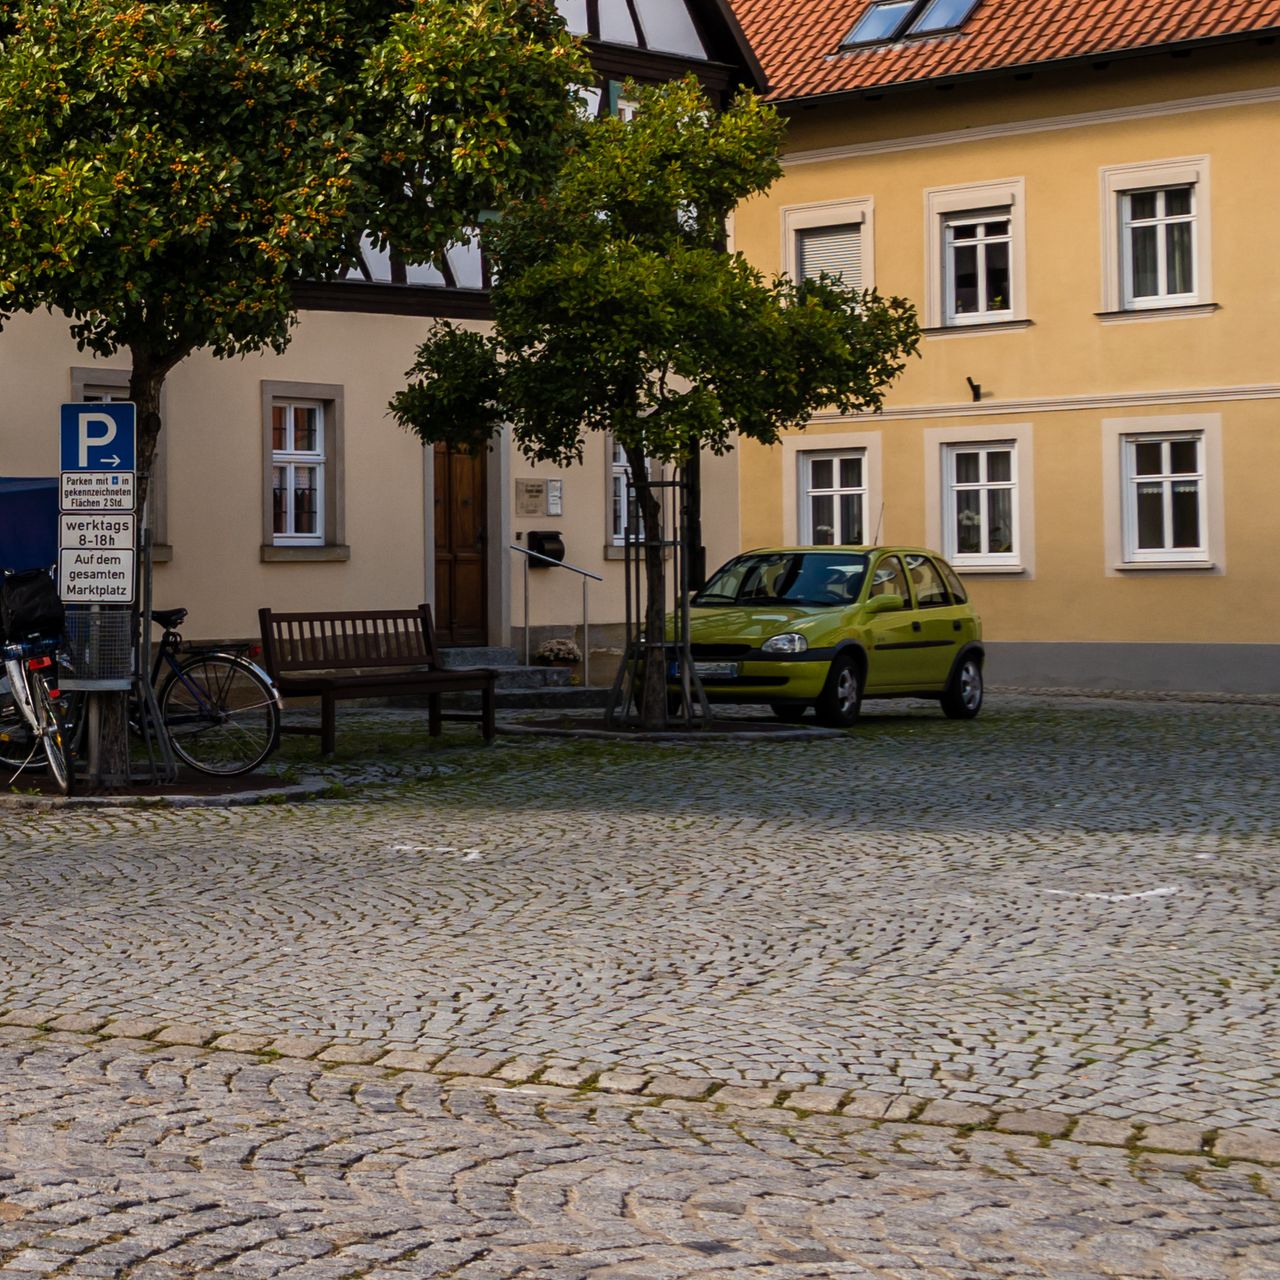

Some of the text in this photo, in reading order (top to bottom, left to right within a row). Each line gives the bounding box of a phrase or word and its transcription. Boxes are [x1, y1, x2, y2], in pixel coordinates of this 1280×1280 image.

[78, 412, 117, 467] P
[66, 476, 129, 485] Parken mit in
[64, 487, 131, 498] gekennzeichneten
[71, 498, 124, 507] Flächen 2 Std.
[66, 519, 129, 534] werktags
[74, 553, 121, 565] Auf dem
[69, 569, 125, 582] gesamten
[66, 584, 127, 598] Marktplatz
